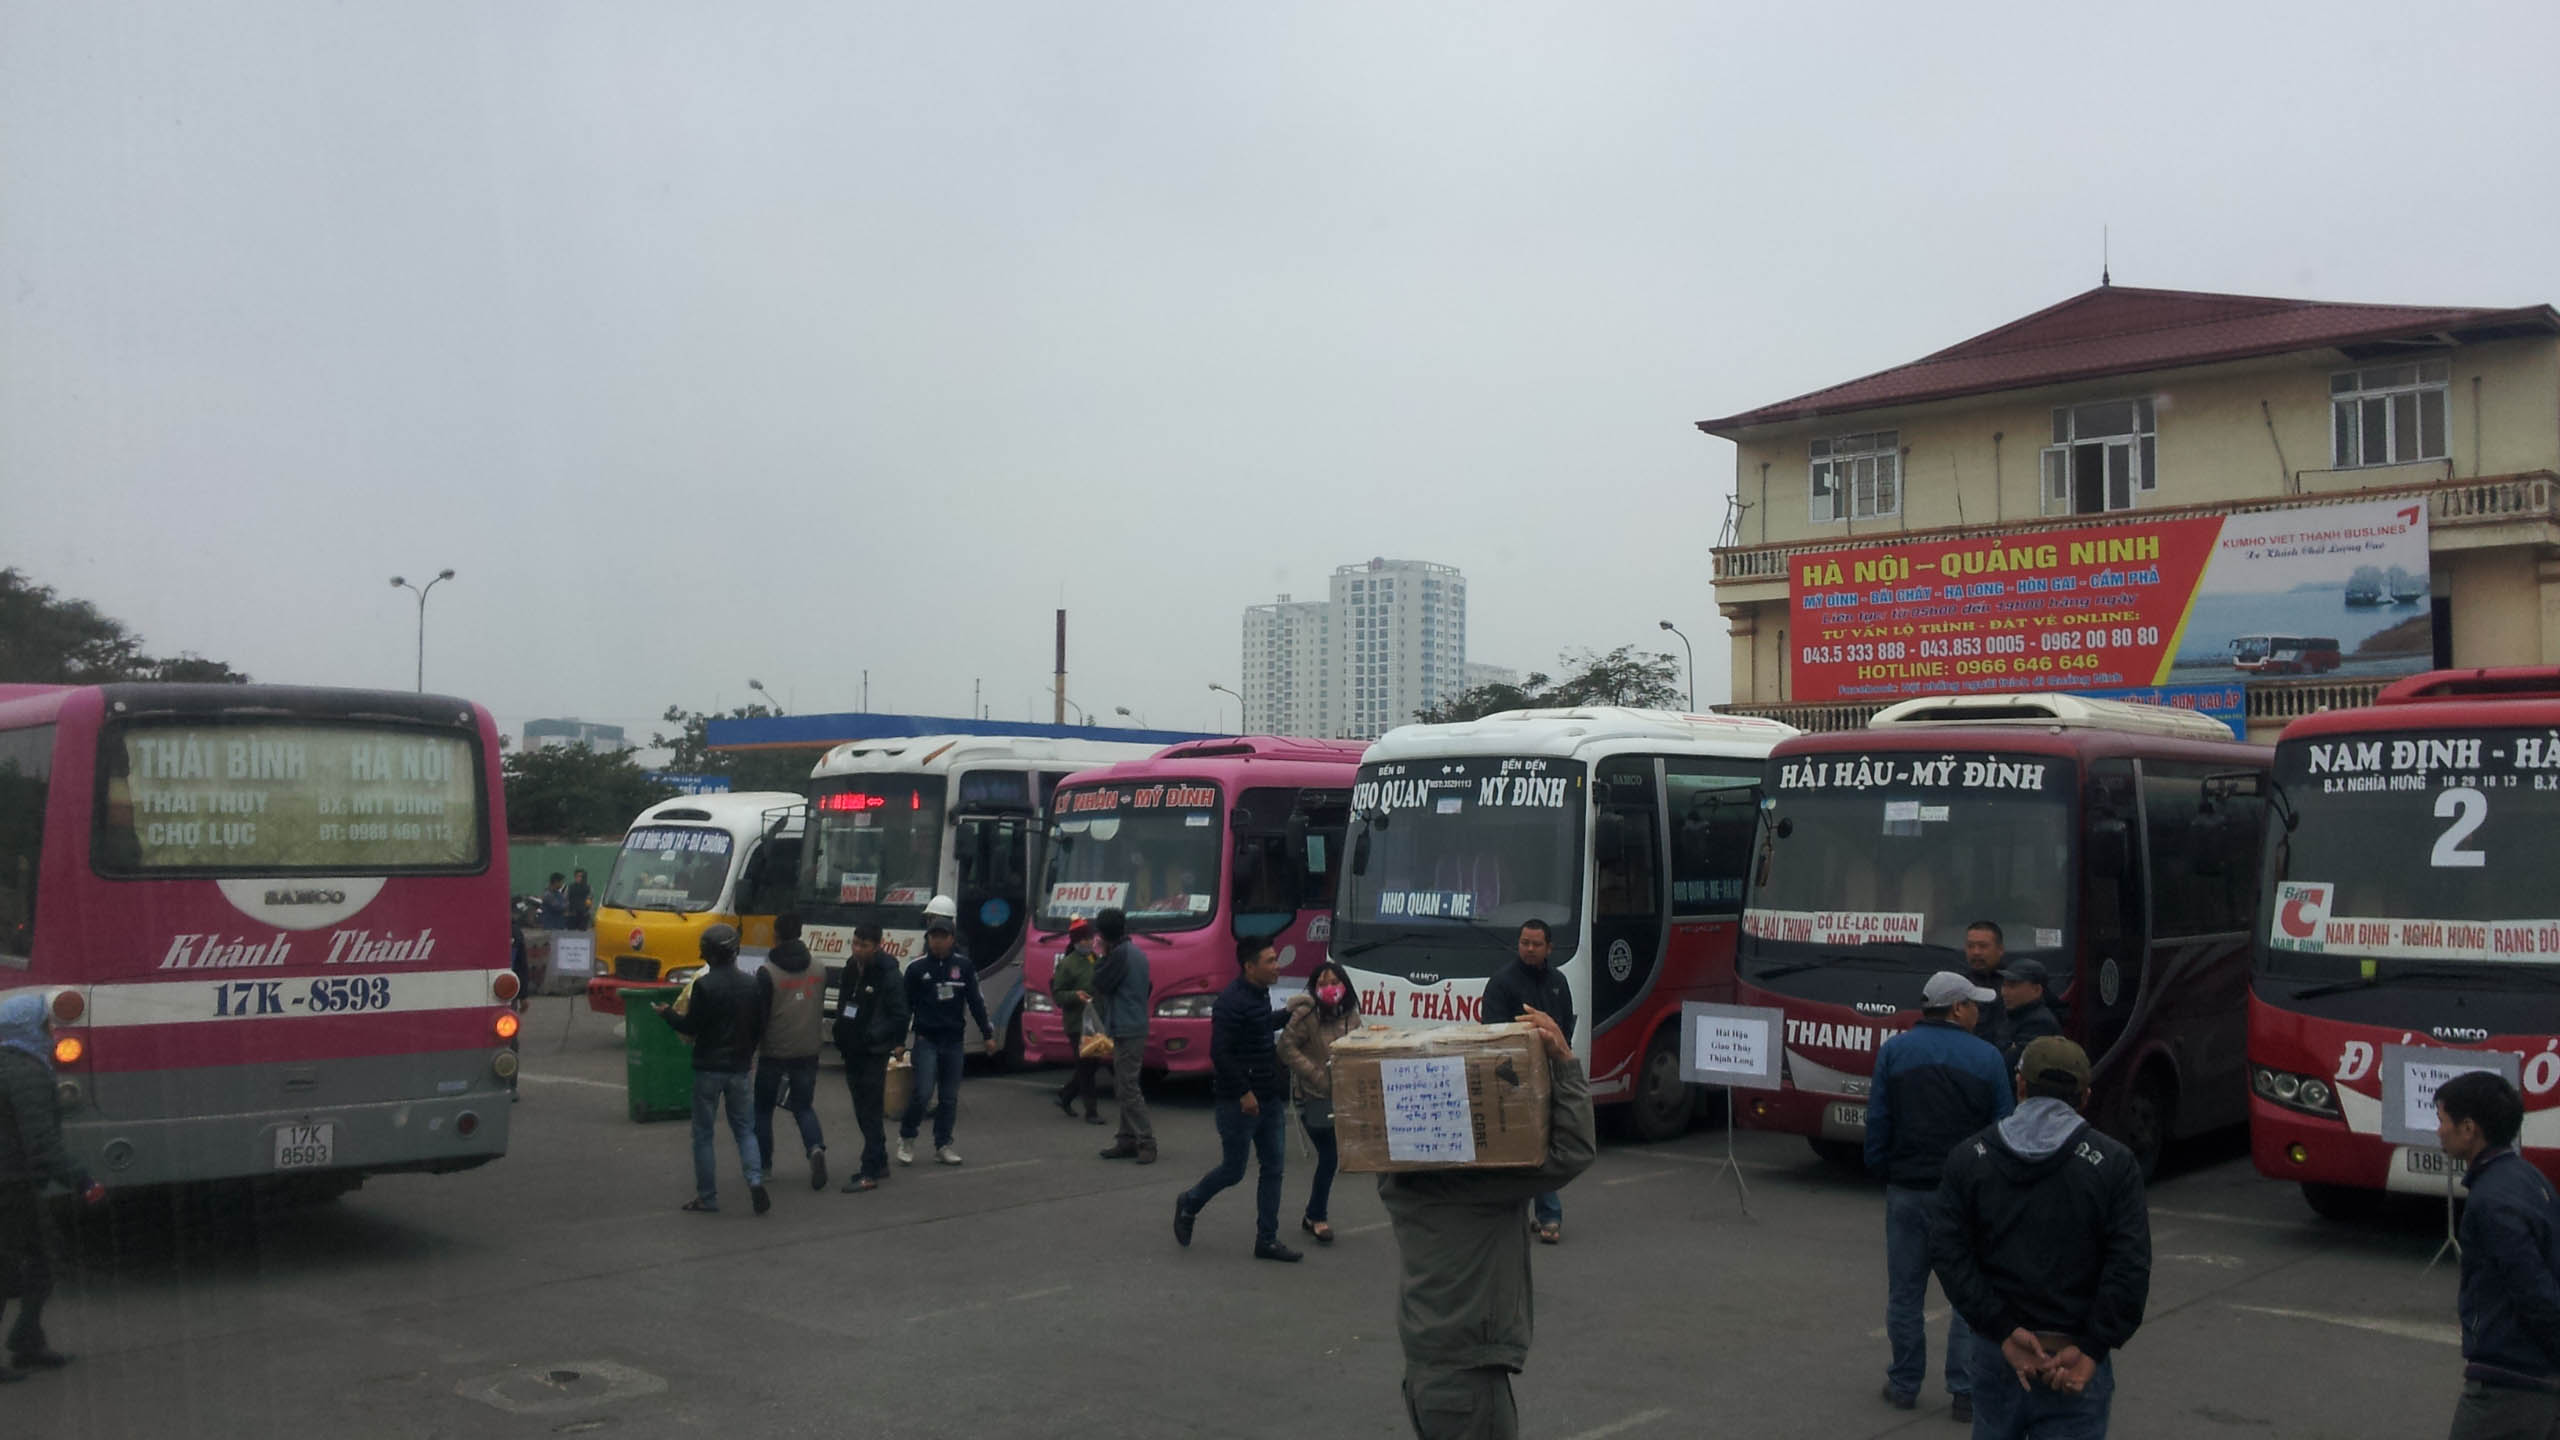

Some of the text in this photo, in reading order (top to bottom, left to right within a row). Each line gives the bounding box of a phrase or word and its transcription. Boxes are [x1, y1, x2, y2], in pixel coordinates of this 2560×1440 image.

[2222, 524, 2408, 549] KUMHO VIET THANH BUSLINES
[1802, 535, 2161, 587] HÀ NỘI QUẢNG NINH
[1803, 593, 1823, 609] MỸ
[1827, 592, 1858, 606] ĐÌNH
[1869, 590, 1894, 605] BÃI
[1896, 587, 1932, 602] CHÁY
[1966, 582, 2005, 596] LONG
[2016, 577, 2048, 594] HÒN
[2050, 575, 2077, 591] GAI
[1919, 619, 1976, 634] TRÌNH
[2063, 611, 2141, 625] ONLINE:
[1803, 626, 2159, 665] 043.5 333 888 043.853 0005 0962 00 80 80
[1858, 654, 2100, 679] HOTLINE: 0966 646 646
[2308, 741, 2384, 774] NAM
[2391, 739, 2483, 775] ĐỊNH
[1780, 756, 1827, 789] HẢI
[1962, 755, 2046, 790] ĐÌNH
[2323, 780, 2344, 793] B.X
[2347, 775, 2387, 790] NGHĨA
[2389, 774, 2426, 790] HƯNG
[2503, 776, 2518, 787] 13
[1072, 787, 1119, 812] NHÂN
[1133, 785, 1163, 808] MỸ
[1165, 784, 1216, 808] ĐÌNH
[1353, 783, 1379, 811] NHO
[1380, 779, 1430, 815] QUAN
[1478, 770, 1511, 806] MỸ
[1511, 771, 1567, 808] ĐÌNH
[2430, 787, 2488, 867] 2
[1096, 883, 1118, 900] LÝ
[1381, 892, 1471, 916] NHO QUAN ME
[160, 928, 437, 969] Khánh Thành
[2326, 922, 2486, 950] NAM ĐỊNH NGHĨA HƯNG
[2494, 927, 2535, 957] RẠNG
[1360, 982, 1396, 1017] HẢI
[1856, 1002, 1896, 1014] SAMCO
[1786, 1019, 1872, 1052] THANH
[2433, 1027, 2487, 1039] SAMCO
[290, 1127, 321, 1146] 17K
[281, 1146, 327, 1166] 8593
